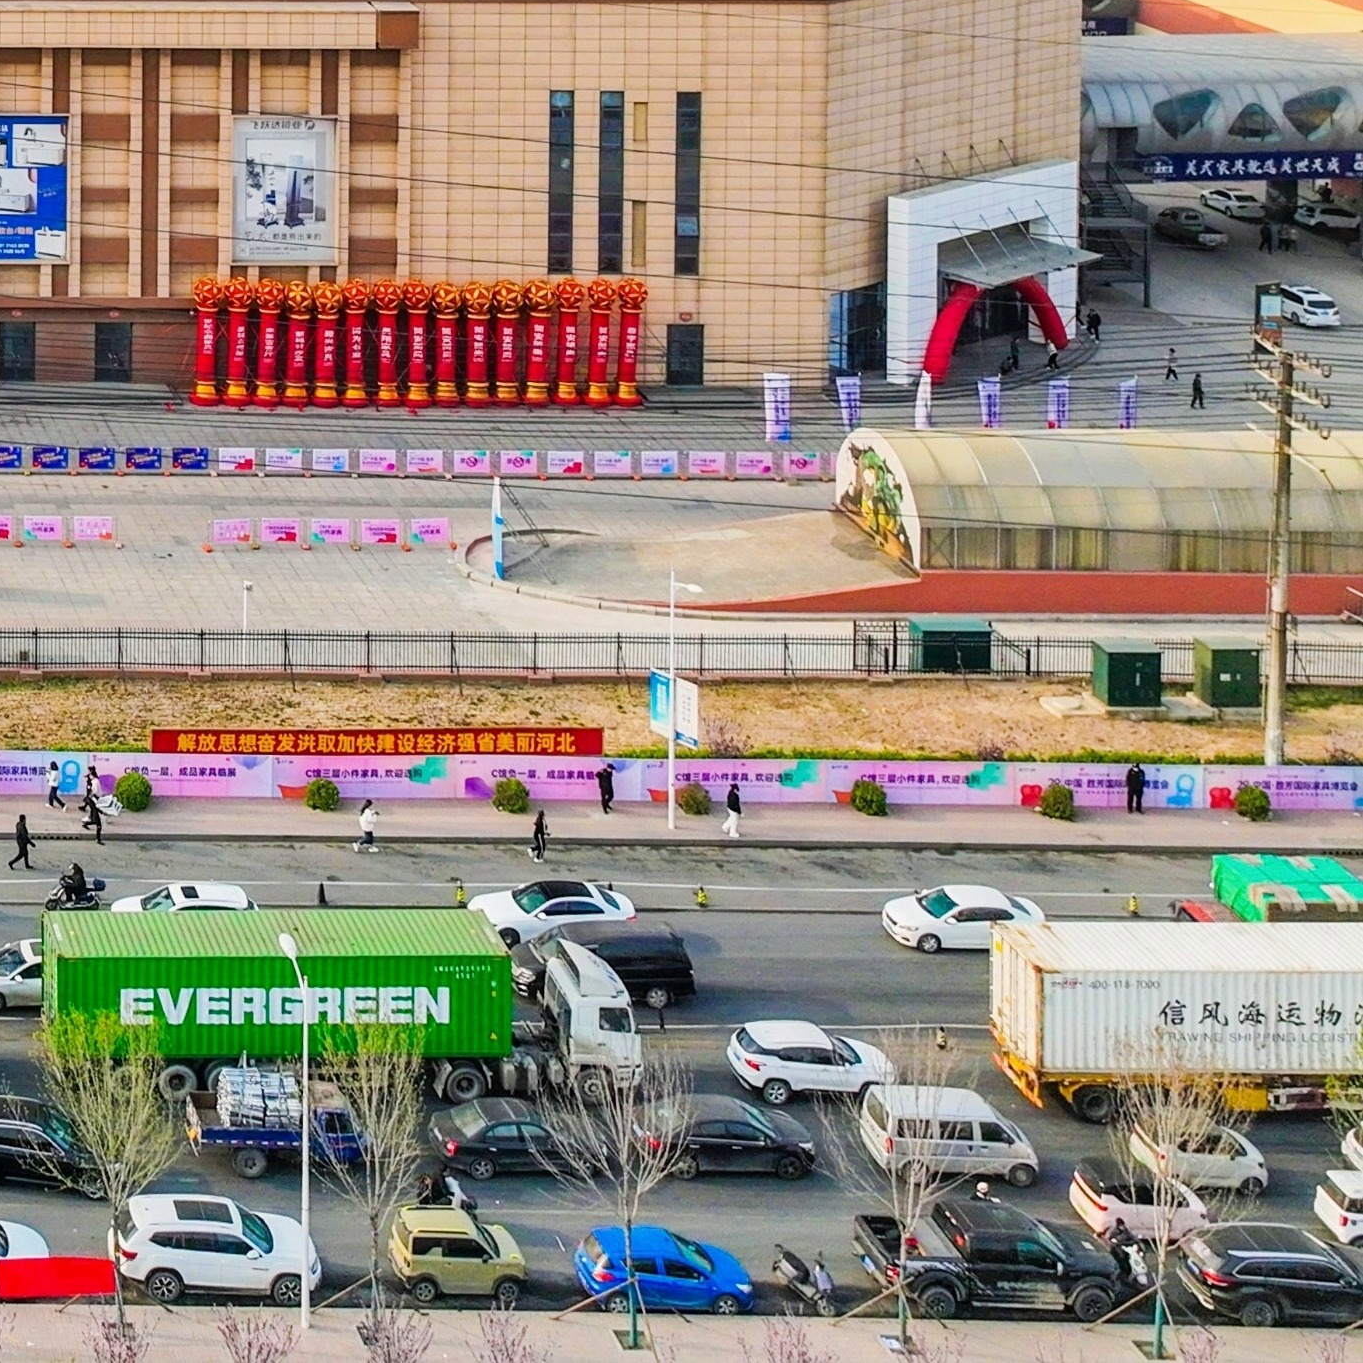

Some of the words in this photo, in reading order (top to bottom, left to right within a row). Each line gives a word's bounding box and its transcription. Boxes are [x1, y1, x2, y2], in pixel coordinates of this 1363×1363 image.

[177, 732, 576, 753] 解放思想奋发进取加快建设经济强省美丽河北
[120, 987, 451, 1025] EVERGREEN
[1159, 999, 1363, 1027] 信风海运物
[1301, 1032, 1359, 1043] LOGISTI
